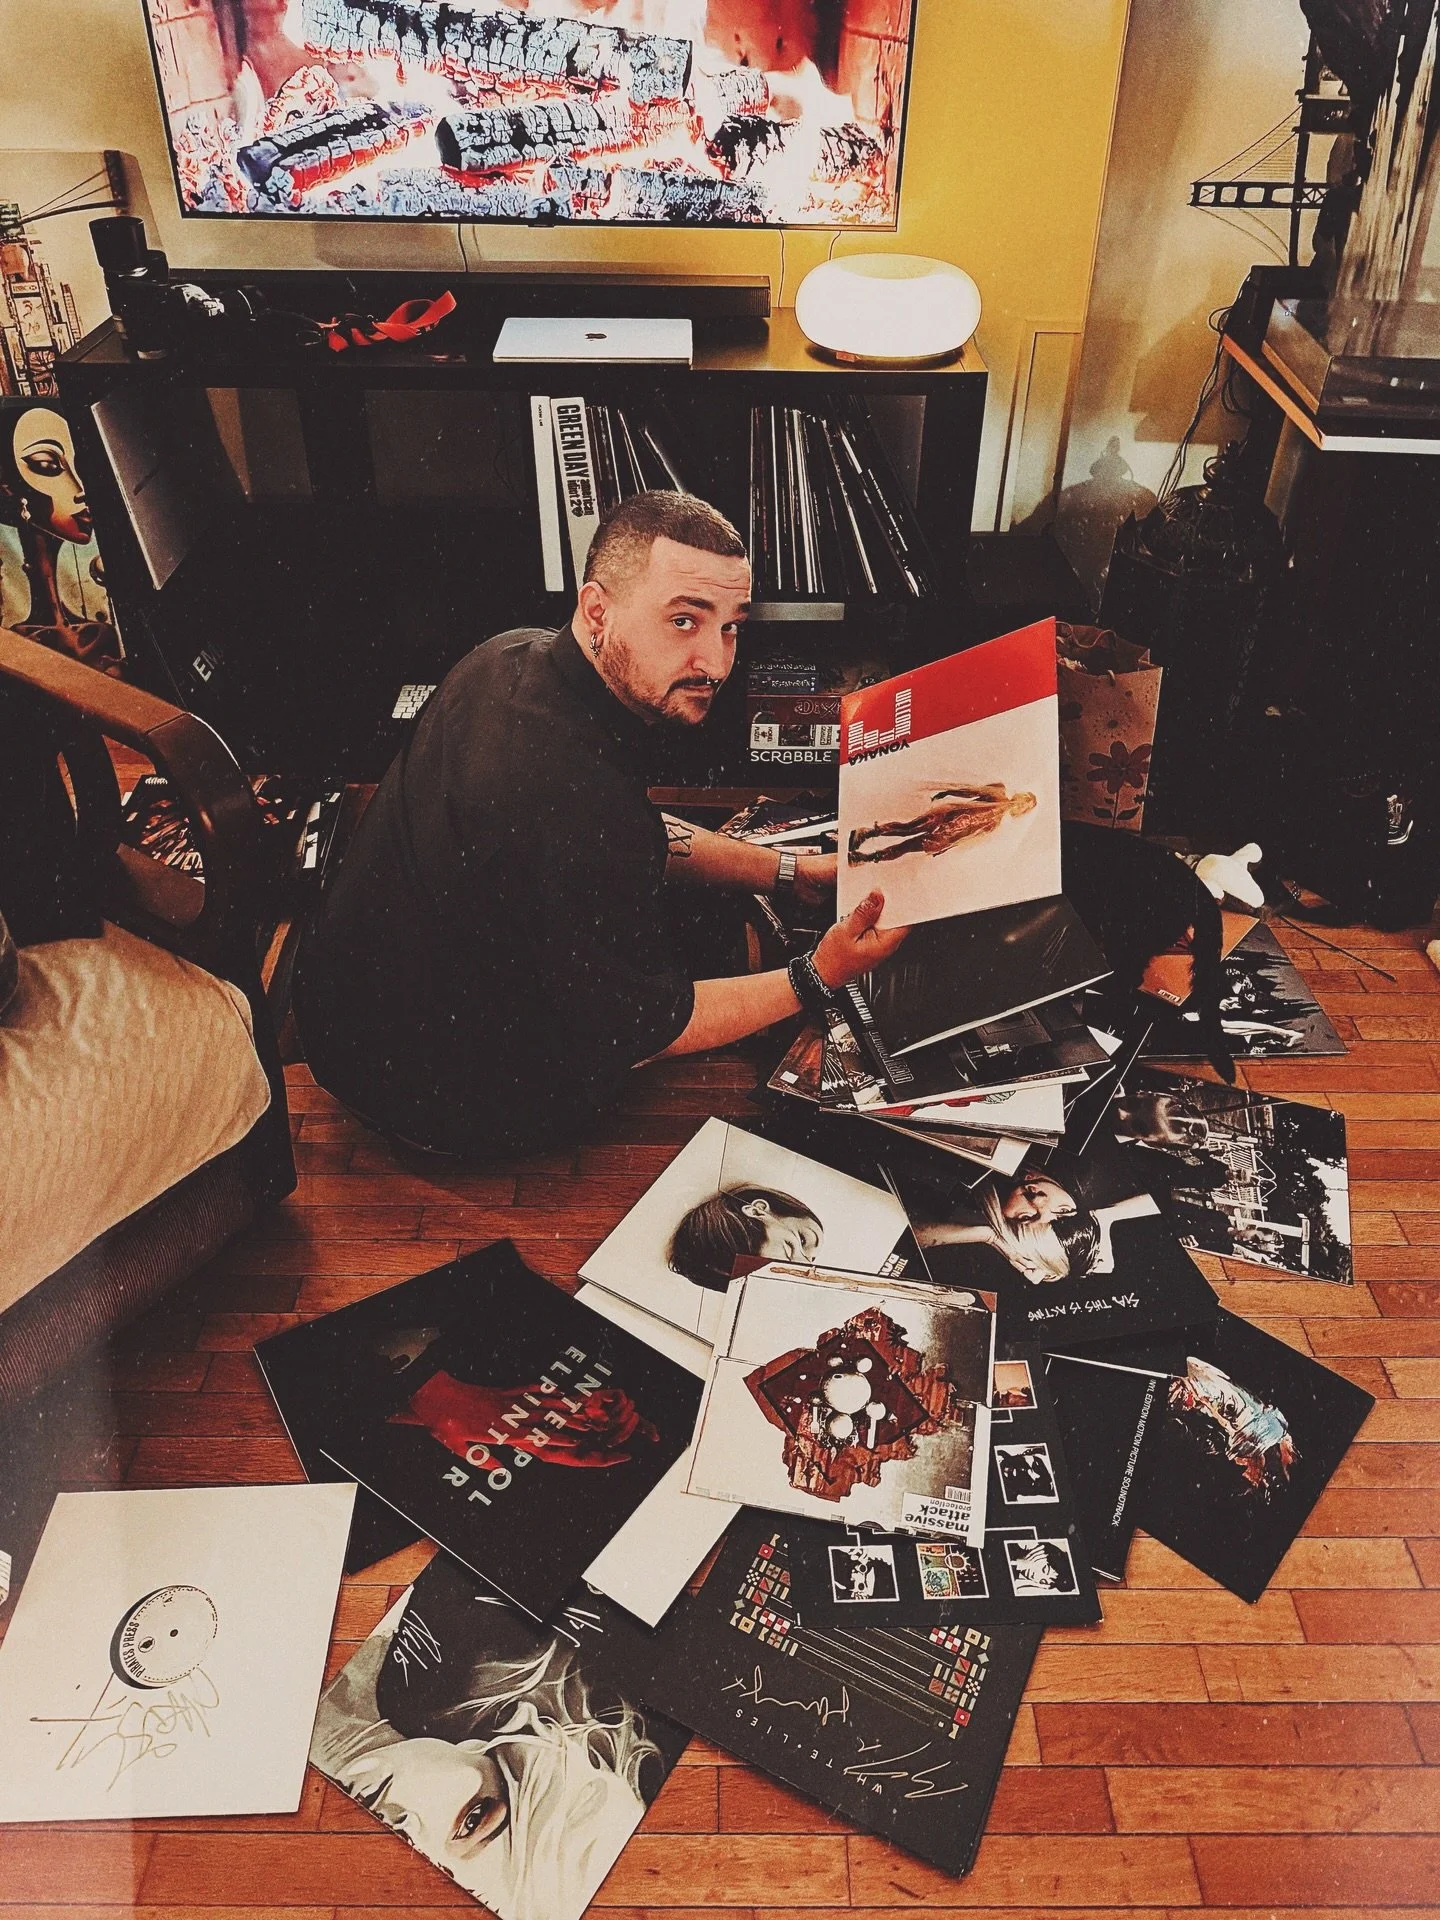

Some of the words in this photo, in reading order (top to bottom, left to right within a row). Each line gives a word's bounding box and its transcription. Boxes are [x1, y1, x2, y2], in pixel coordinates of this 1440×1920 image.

[557, 405, 585, 450] GREEN
[564, 451, 590, 480] DAY
[567, 479, 581, 498] idiot
[580, 480, 596, 516] american
[896, 689, 911, 739] WELCOME
[880, 728, 895, 744] TO
[750, 750, 832, 764] SCRABBLE
[848, 740, 910, 766] YONAKA
[1140, 1394, 1153, 1419] EDITION
[468, 1362, 612, 1506] INTERPOL
[1133, 1419, 1146, 1446] MOTION
[1124, 1446, 1139, 1476] PICTURE
[919, 1504, 970, 1521] attack
[930, 1499, 971, 1511] protection
[1111, 1476, 1131, 1526] SOUNDTRACK
[905, 1514, 969, 1532] massive
[123, 1622, 139, 1648] PRESS
[123, 1648, 145, 1678] PIRATES
[735, 1708, 789, 1744] LIES
